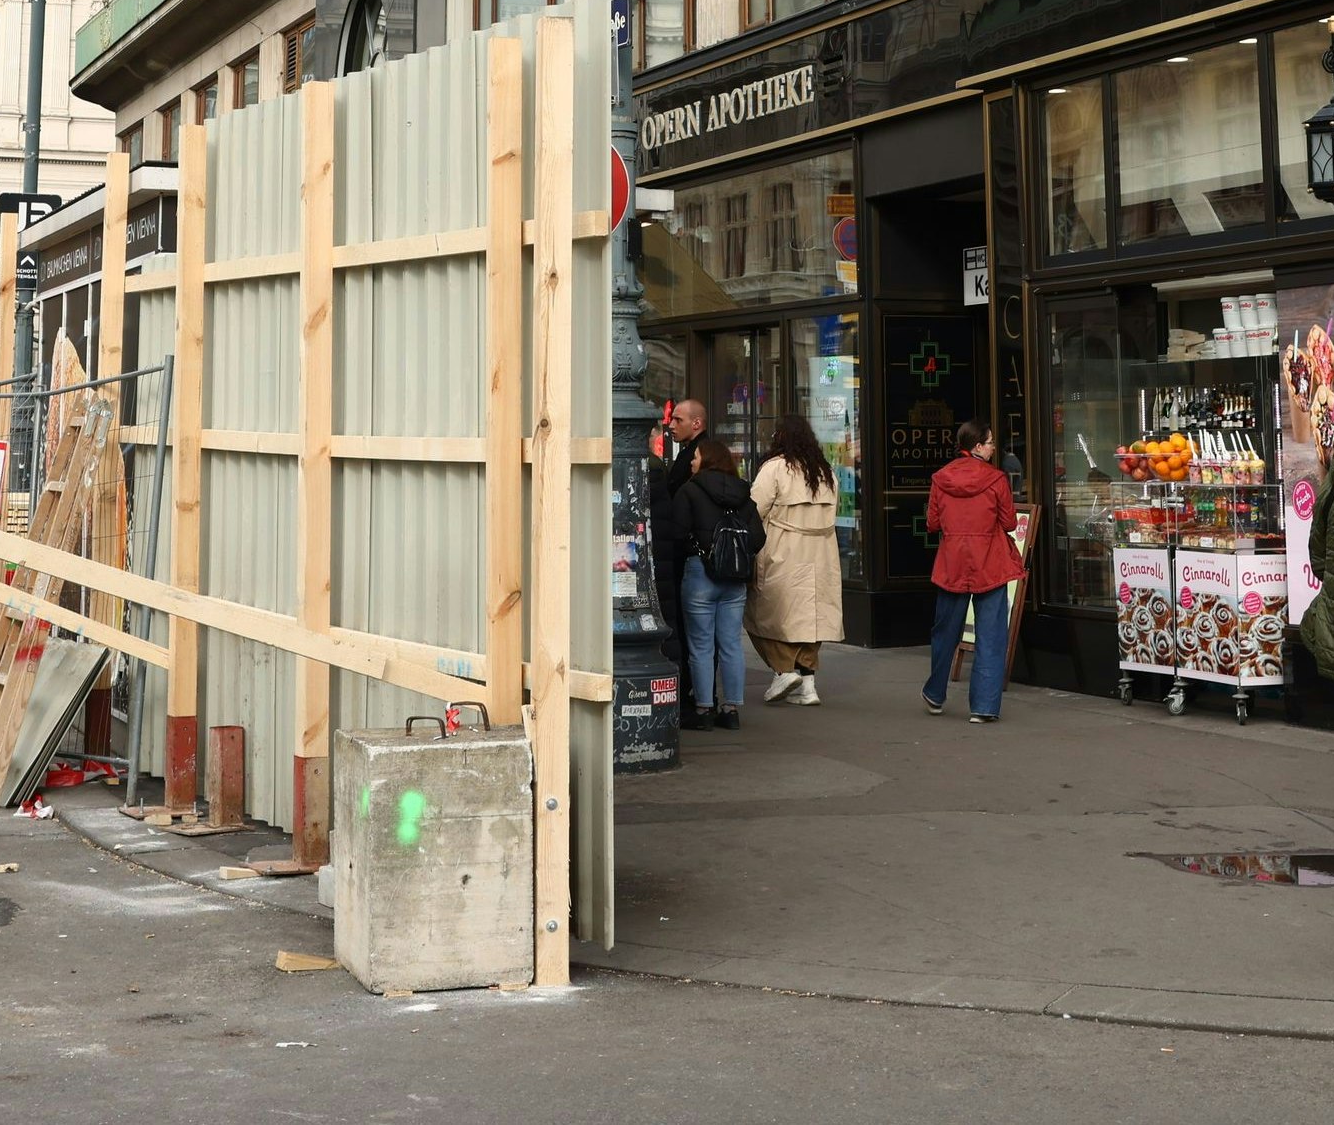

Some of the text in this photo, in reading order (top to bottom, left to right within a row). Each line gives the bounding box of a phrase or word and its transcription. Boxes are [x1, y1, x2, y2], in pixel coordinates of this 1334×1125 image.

[641, 65, 815, 150] OPERN APOTHEKE
[975, 275, 990, 297] Ka
[892, 428, 953, 445] OPER
[891, 448, 959, 459] APOTHE
[1120, 561, 1164, 581] Cinnarolls
[1182, 565, 1231, 588] Cinnarolls
[1241, 571, 1288, 587] Cinnar
[651, 678, 677, 691] OMEGA
[653, 690, 678, 704] DORIS
